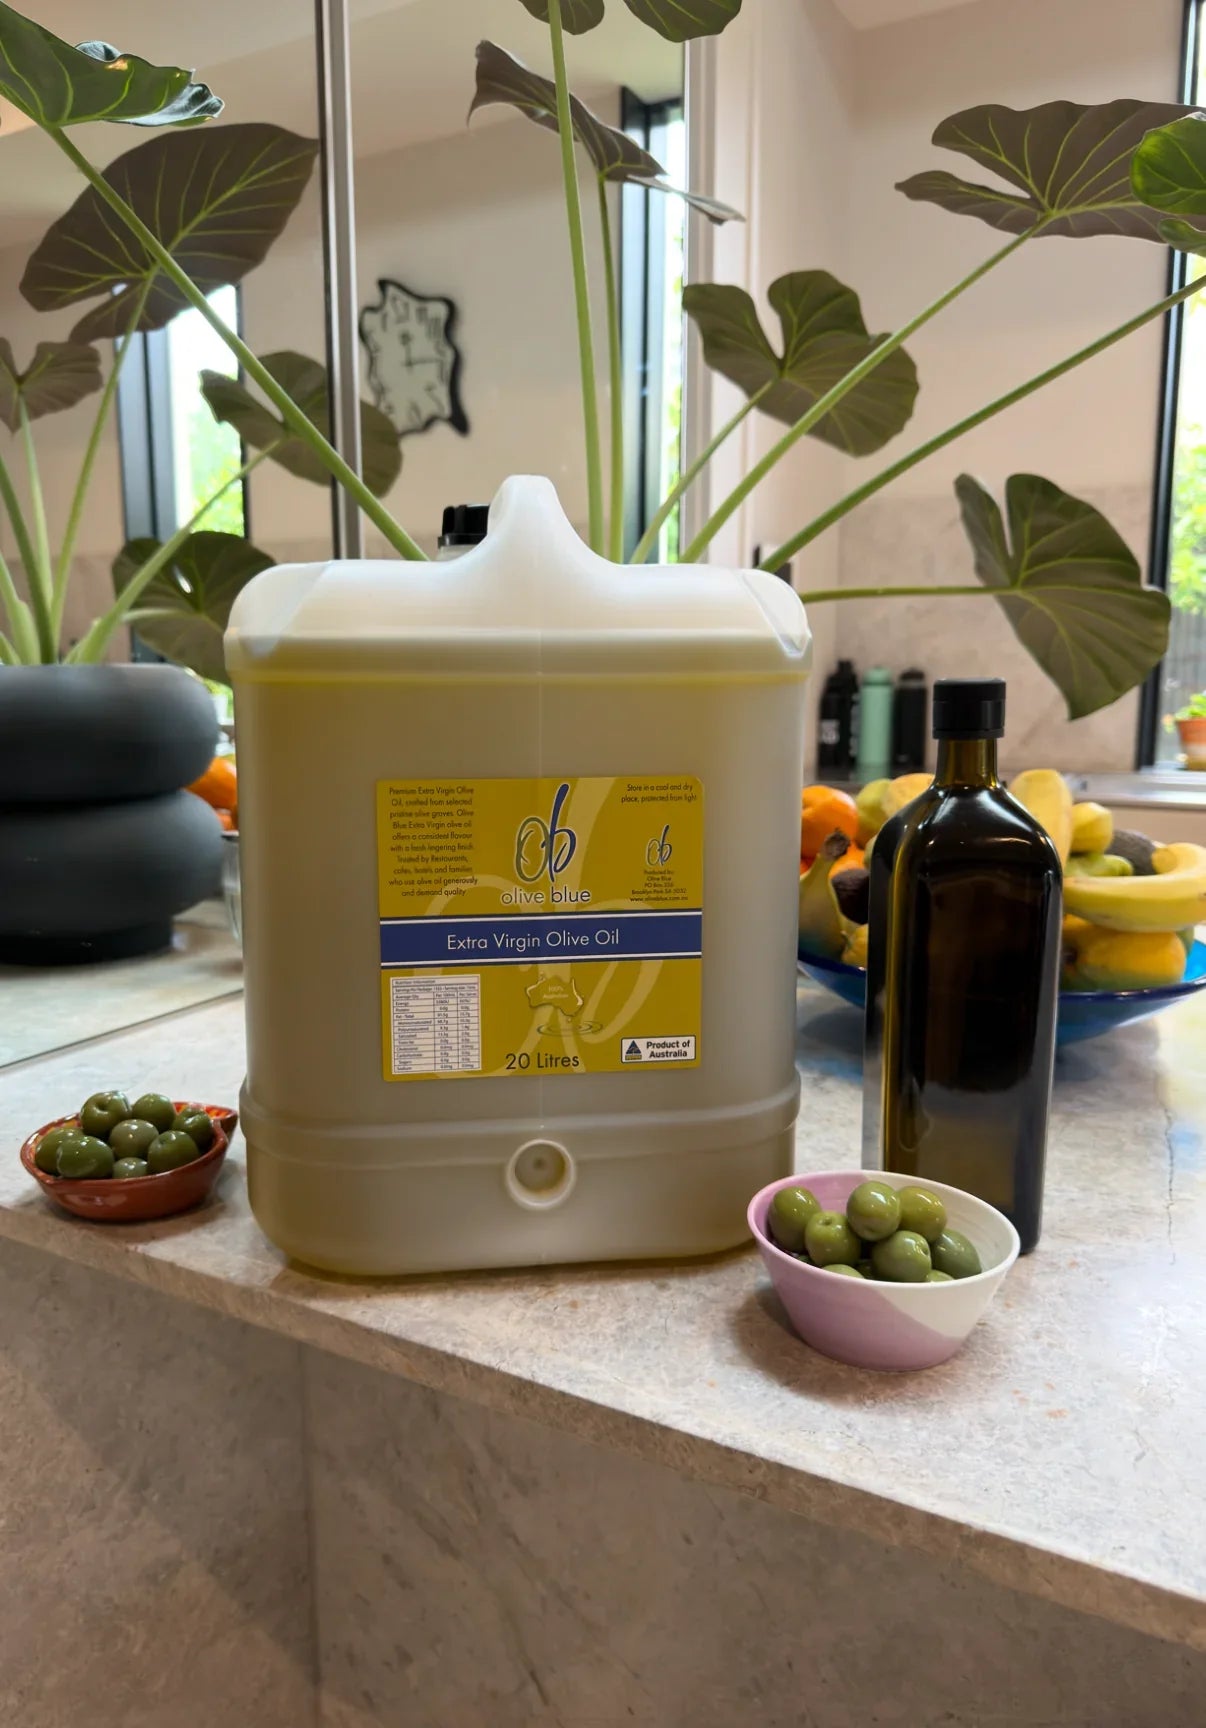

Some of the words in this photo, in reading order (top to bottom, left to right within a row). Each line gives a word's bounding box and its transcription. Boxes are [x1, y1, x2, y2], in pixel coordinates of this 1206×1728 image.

[389, 787, 416, 795] Premium
[418, 786, 434, 795] Extra
[436, 786, 455, 796] Virgin
[456, 786, 474, 795] Olive
[627, 784, 642, 792] Store
[656, 783, 669, 791] cool
[670, 783, 682, 791] and
[683, 782, 693, 792] dry
[430, 798, 444, 806] from
[446, 798, 473, 806] selected
[641, 794, 669, 803] protected
[670, 793, 683, 801] from
[456, 809, 474, 817] Olive
[393, 821, 407, 829] Blue
[409, 821, 425, 829] Extra
[426, 821, 445, 830] Virgin
[447, 820, 462, 828] olive
[418, 832, 449, 840] consistent
[450, 831, 473, 839] flavour
[421, 855, 430, 864] by
[417, 877, 432, 885] olive
[443, 876, 478, 886] generously
[402, 889, 415, 897] and
[416, 888, 442, 896] demand
[444, 887, 467, 897] quality
[502, 887, 545, 905] olive
[551, 886, 591, 903] blue
[448, 935, 488, 950] Extra
[493, 933, 541, 952] Virgin
[546, 930, 590, 947] Olive
[595, 928, 619, 945] Oil
[646, 1041, 680, 1049] Product
[649, 1050, 688, 1058] Australia
[505, 1053, 531, 1070] 20
[537, 1052, 580, 1069] Litres
